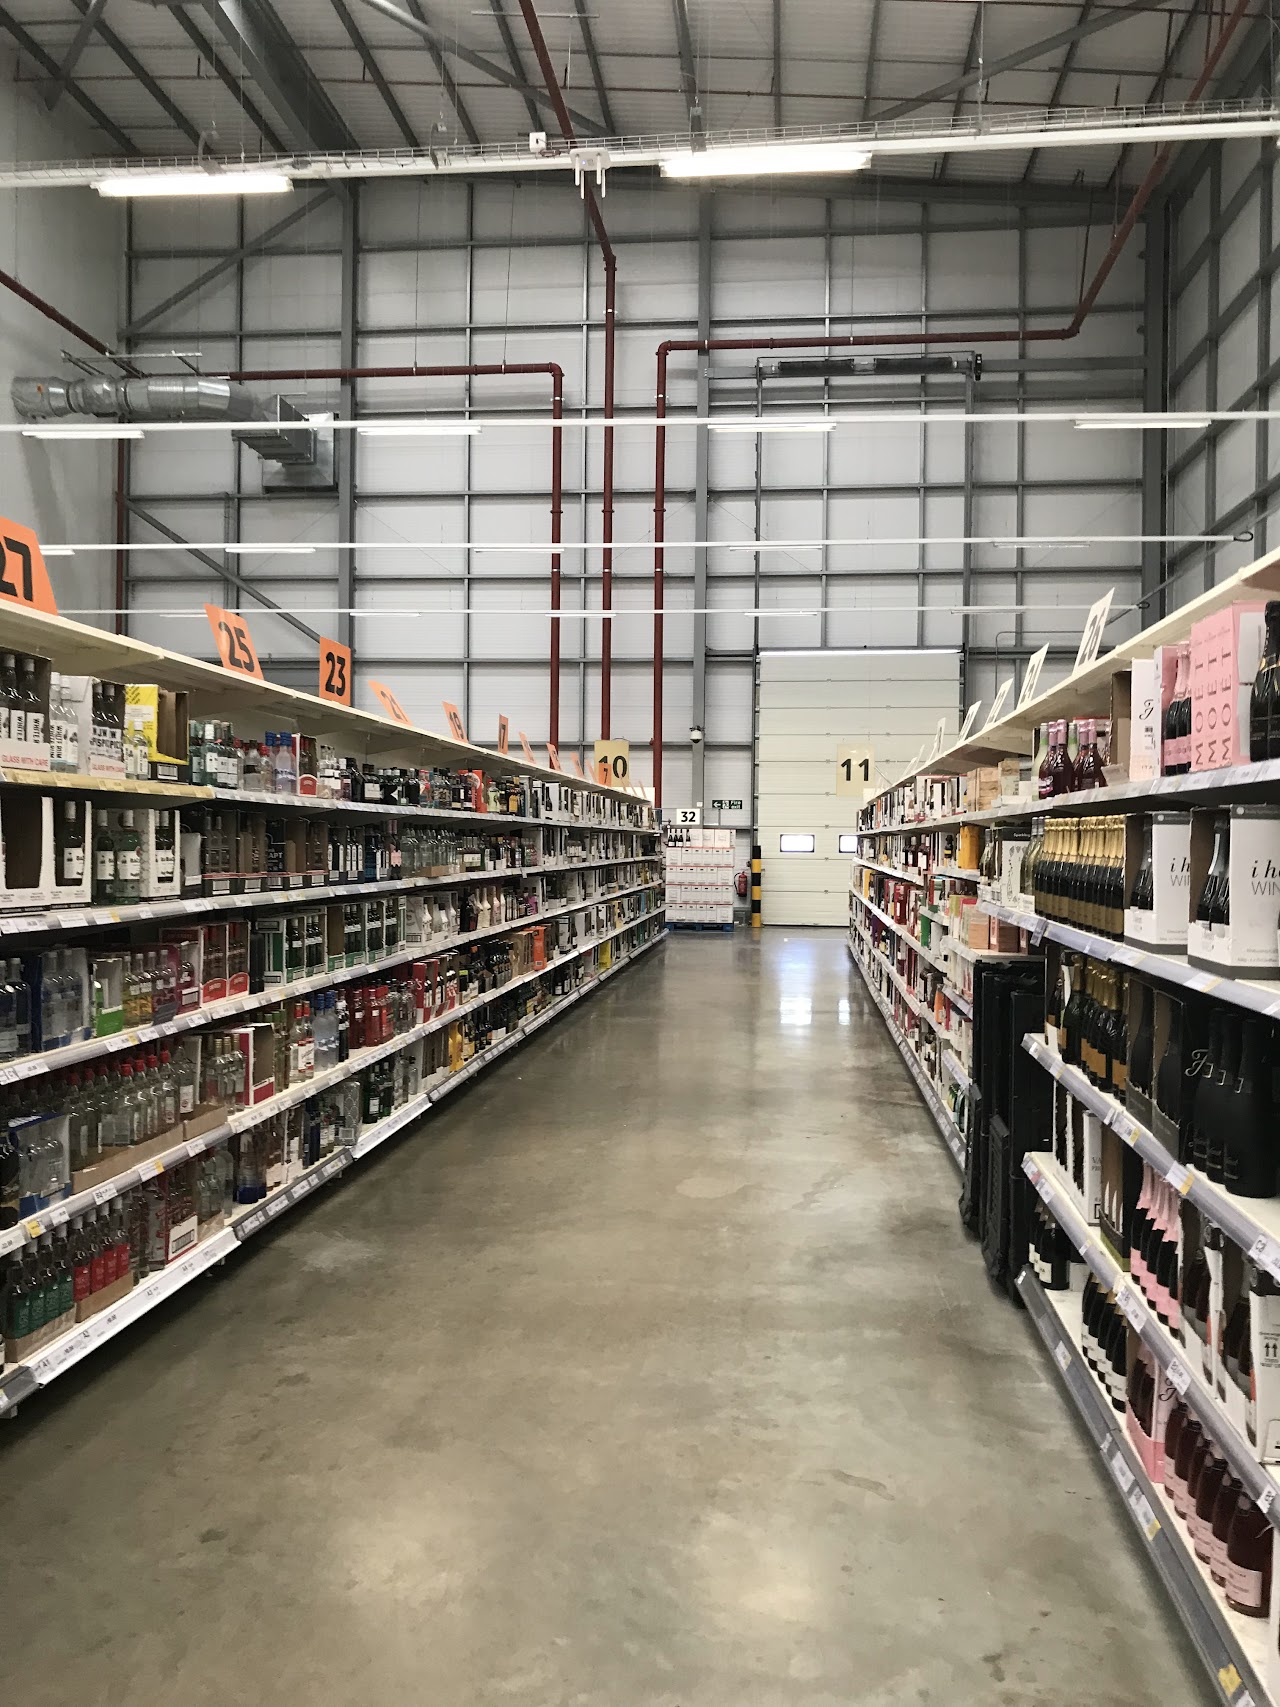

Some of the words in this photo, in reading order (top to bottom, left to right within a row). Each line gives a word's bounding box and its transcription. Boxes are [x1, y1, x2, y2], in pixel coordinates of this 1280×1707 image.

[218, 621, 255, 672] 25
[325, 651, 346, 697] 23
[2, 754, 20, 764] GLASS
[35, 758, 48, 767] CARE
[841, 759, 869, 781] 11
[680, 811, 696, 823] 32
[1264, 859, 1280, 878] h
